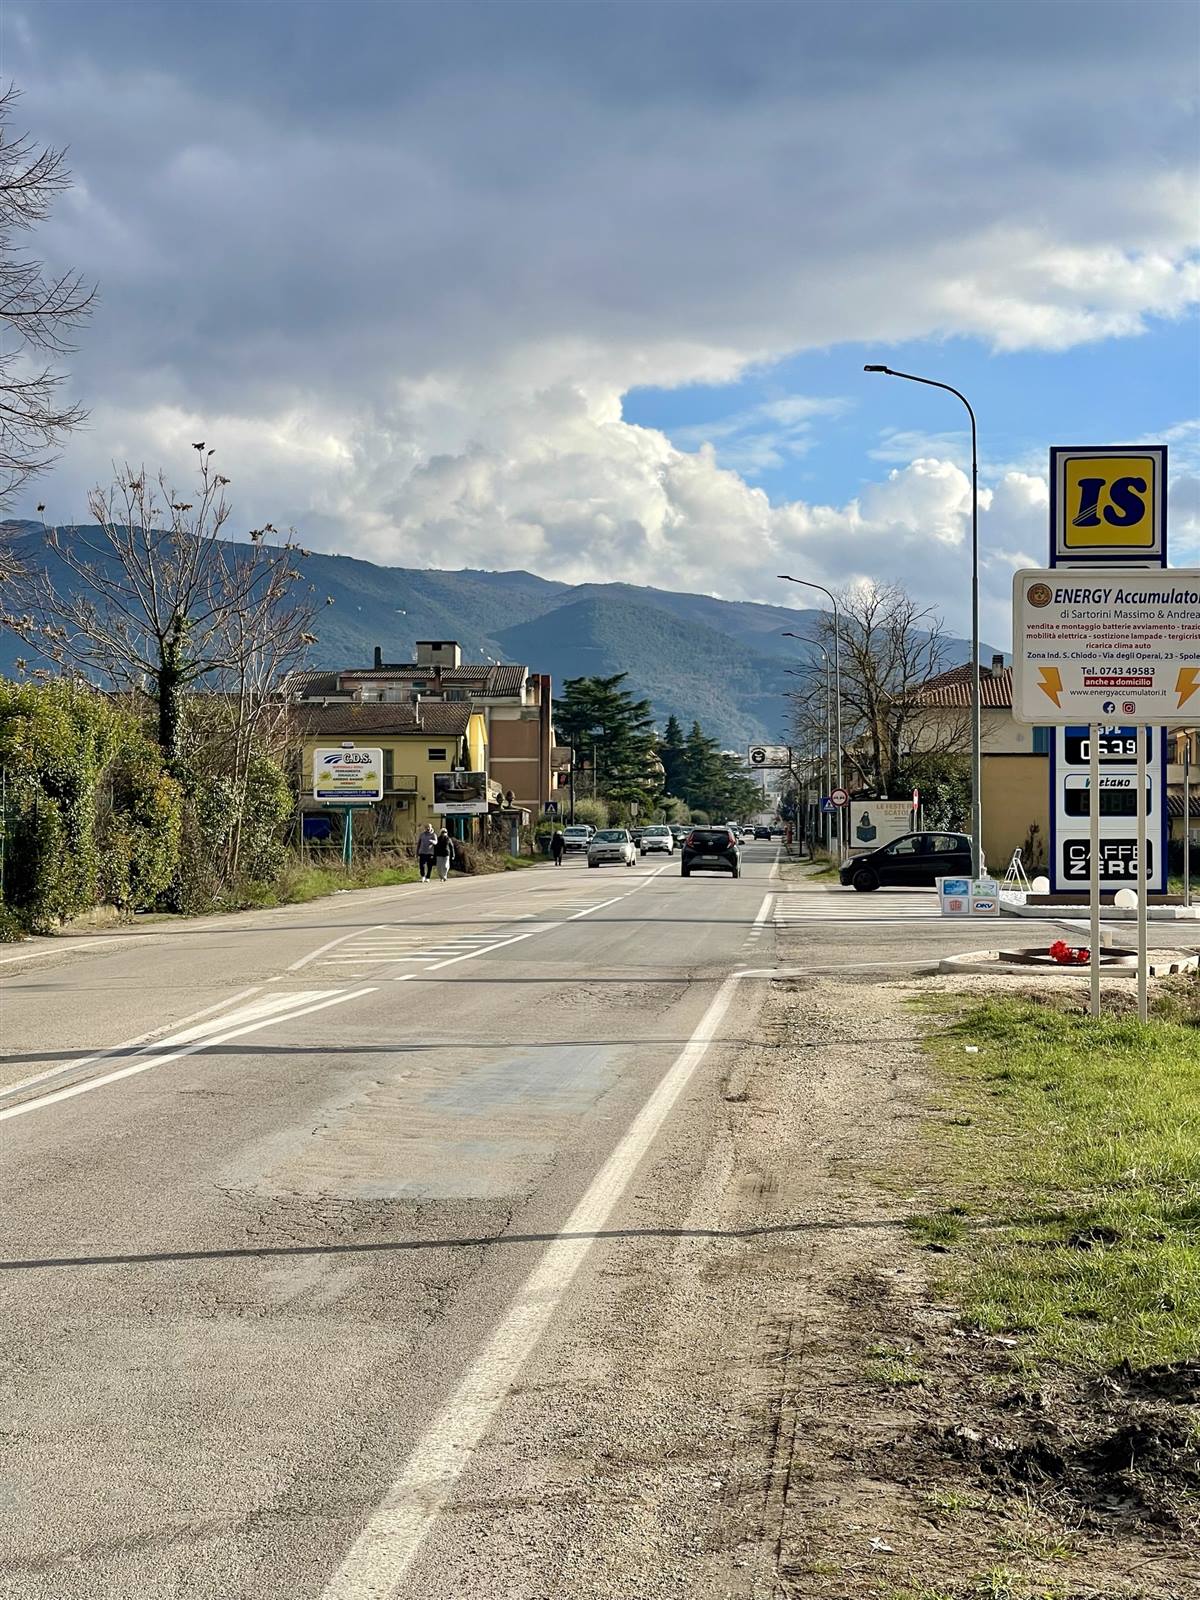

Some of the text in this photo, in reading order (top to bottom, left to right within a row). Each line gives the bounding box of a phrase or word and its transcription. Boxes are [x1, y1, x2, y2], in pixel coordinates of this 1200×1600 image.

[1072, 476, 1147, 527] IS
[1054, 588, 1112, 604] ENERGY
[1060, 609, 1200, 619] di Sartorini Massimo & Andrea
[1061, 623, 1101, 632] montaggio
[1026, 632, 1056, 640] mobilità
[1057, 632, 1088, 640] elettrica
[1093, 632, 1129, 640] sostizione
[1130, 632, 1162, 641] lampade
[1085, 641, 1112, 649] ricarica
[1113, 641, 1133, 649] clima
[1047, 651, 1061, 659] Ind.
[1071, 651, 1097, 659] Chiodo
[1115, 651, 1135, 661] degli
[1164, 652, 1174, 660] 23
[1081, 667, 1155, 675] Tel. 0743 49583
[1085, 678, 1109, 686] anche
[1115, 678, 1151, 686] domicilio
[1069, 688, 1167, 698] www.energyaccumulatori.it
[343, 752, 372, 764] C.D.S.
